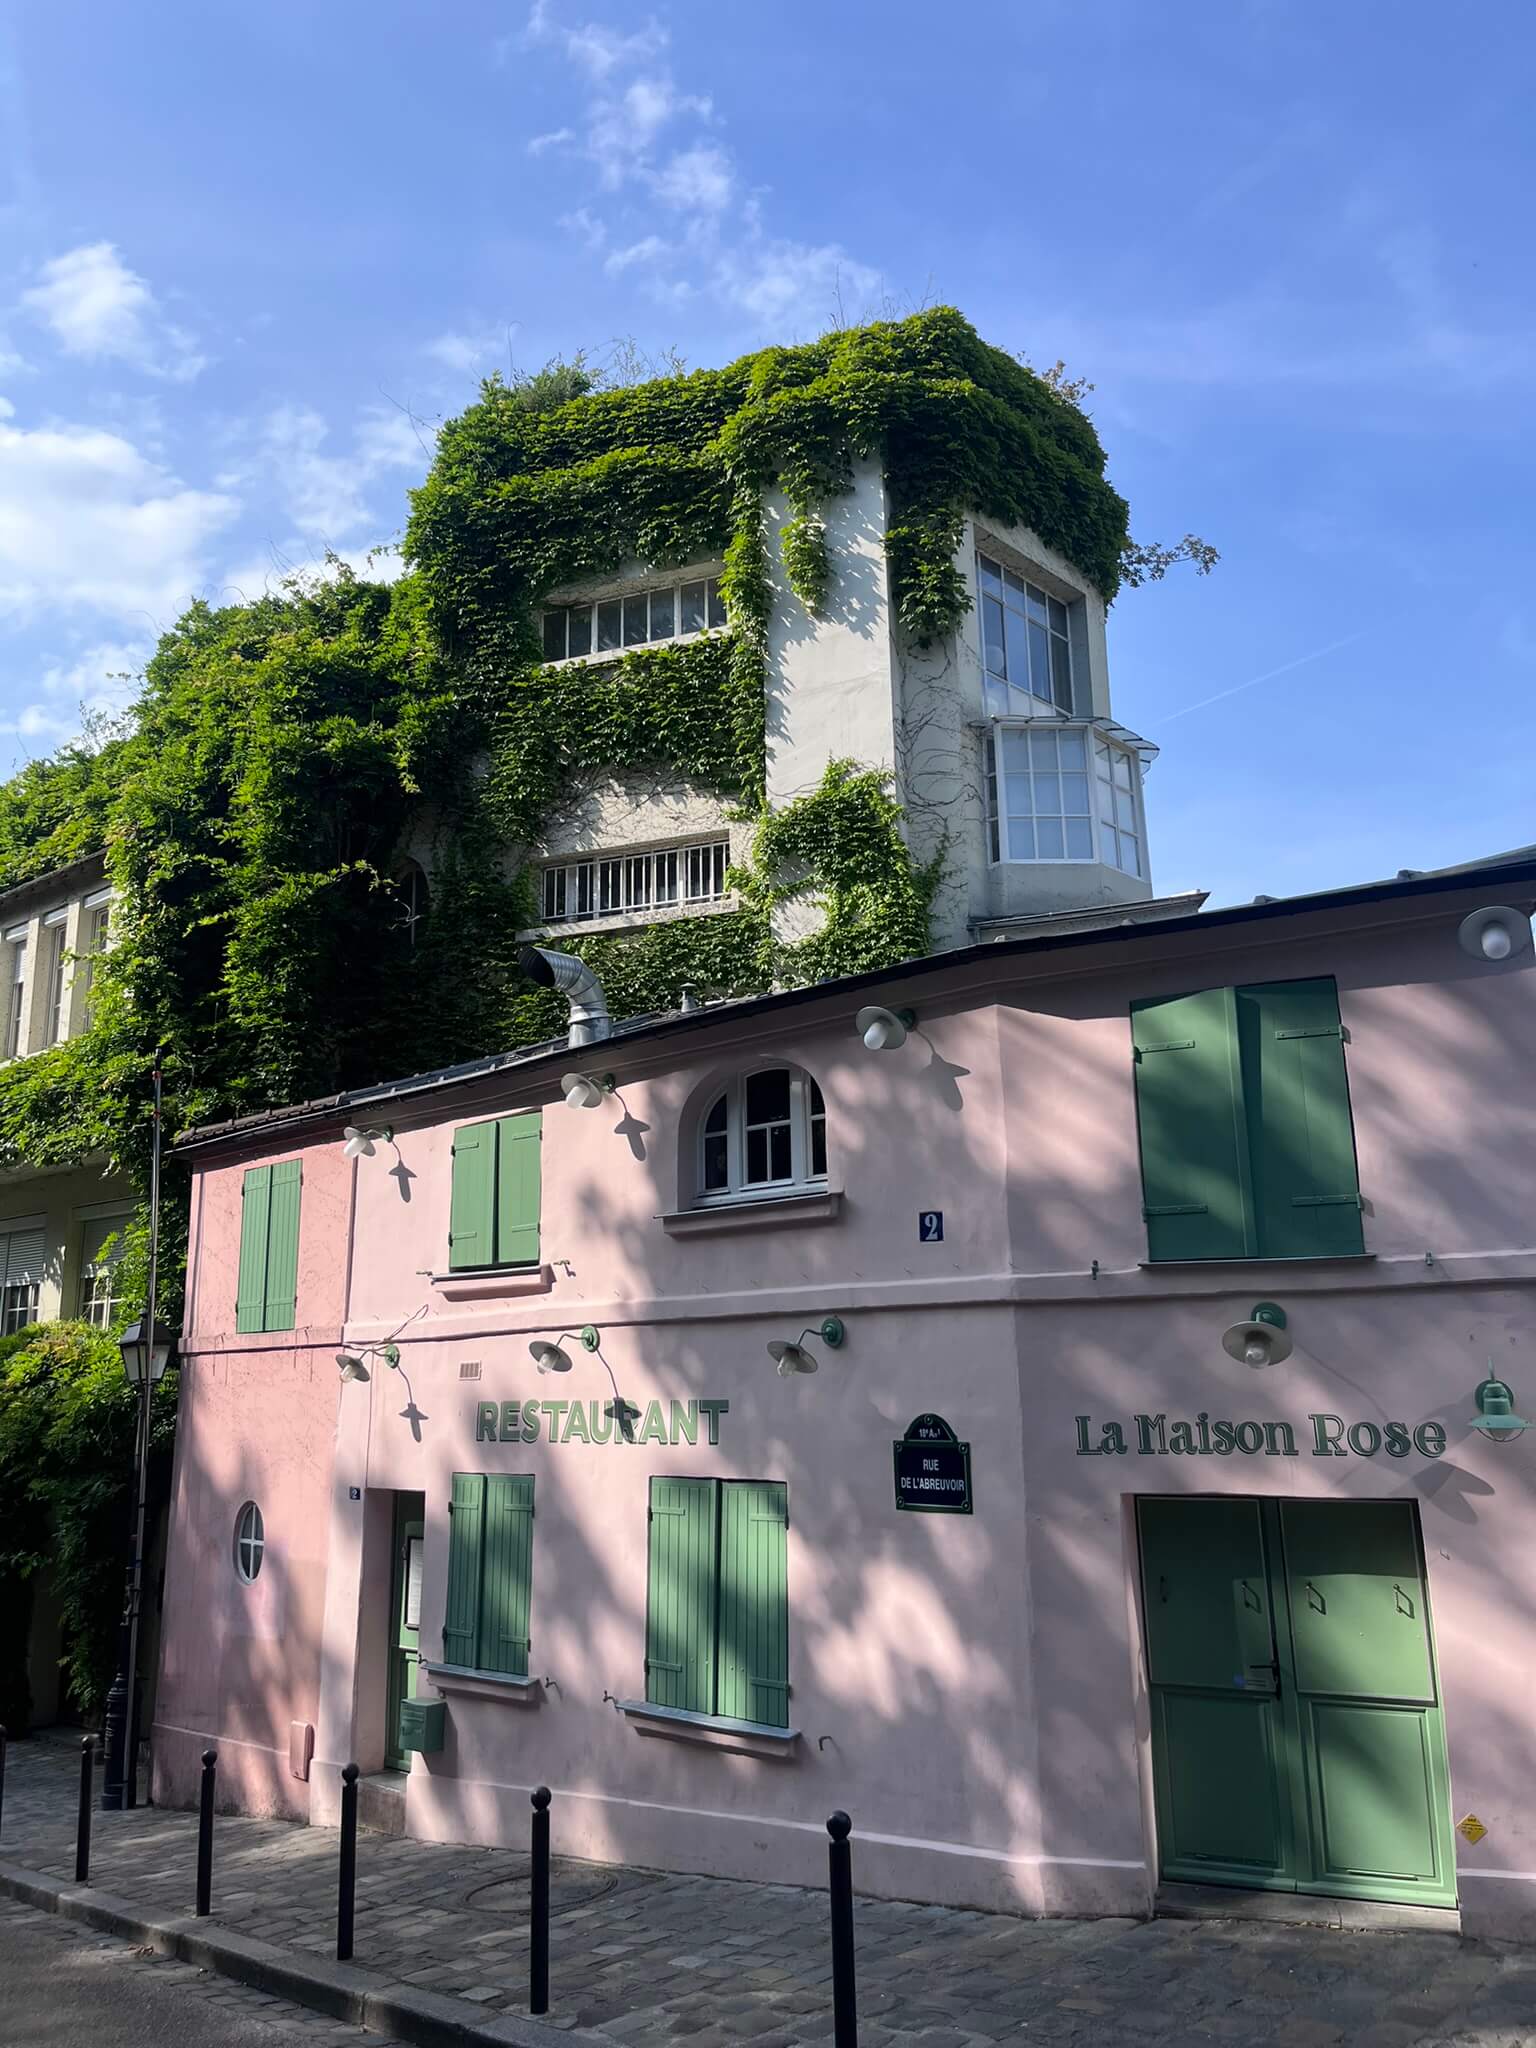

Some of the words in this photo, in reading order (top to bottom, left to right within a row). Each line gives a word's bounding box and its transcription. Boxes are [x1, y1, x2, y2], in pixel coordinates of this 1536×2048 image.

[925, 1214, 938, 1240] 2
[476, 1399, 730, 1445] RESTAURANT
[1075, 1415, 1128, 1456] La
[1133, 1412, 1299, 1456] Maison
[1308, 1413, 1447, 1459] Rose
[922, 1458, 940, 1471] RUE
[900, 1477, 912, 1489] DE
[912, 1477, 965, 1491] L'ABREUVOIR
